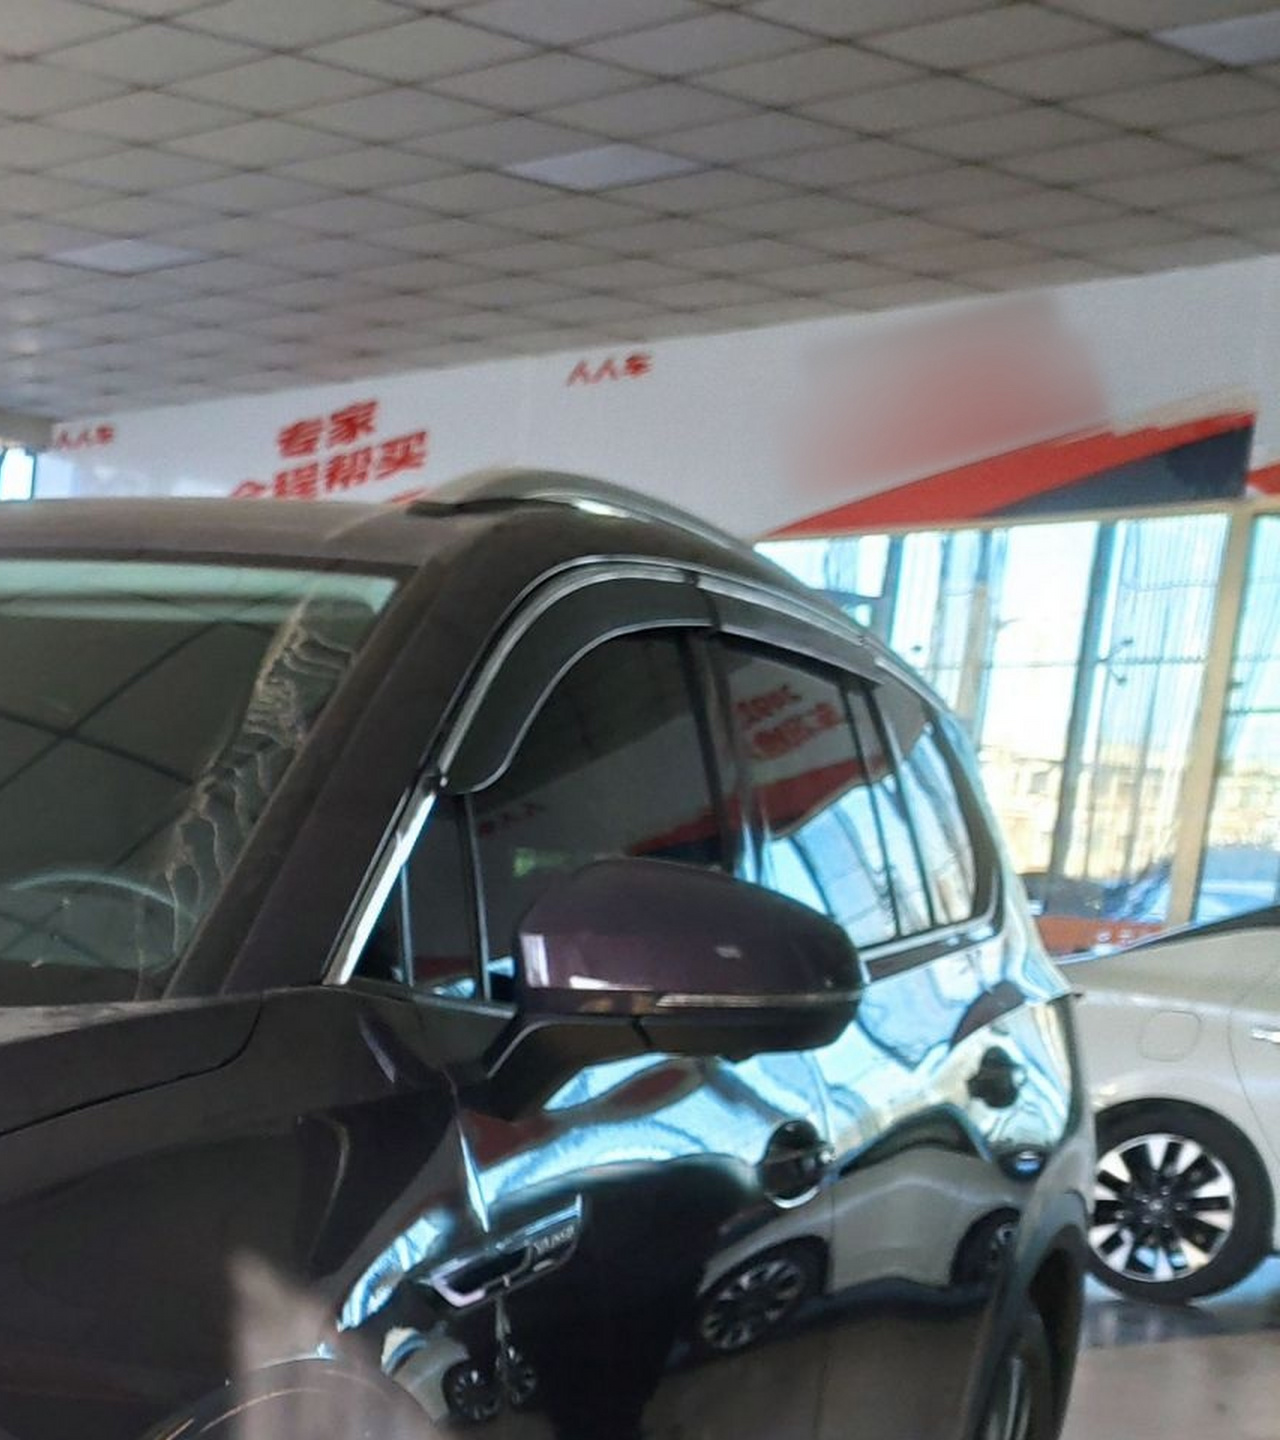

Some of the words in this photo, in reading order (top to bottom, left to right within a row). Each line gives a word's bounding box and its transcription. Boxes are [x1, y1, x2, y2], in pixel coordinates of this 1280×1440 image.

[567, 353, 652, 388] 人人车
[276, 398, 378, 459] 专家
